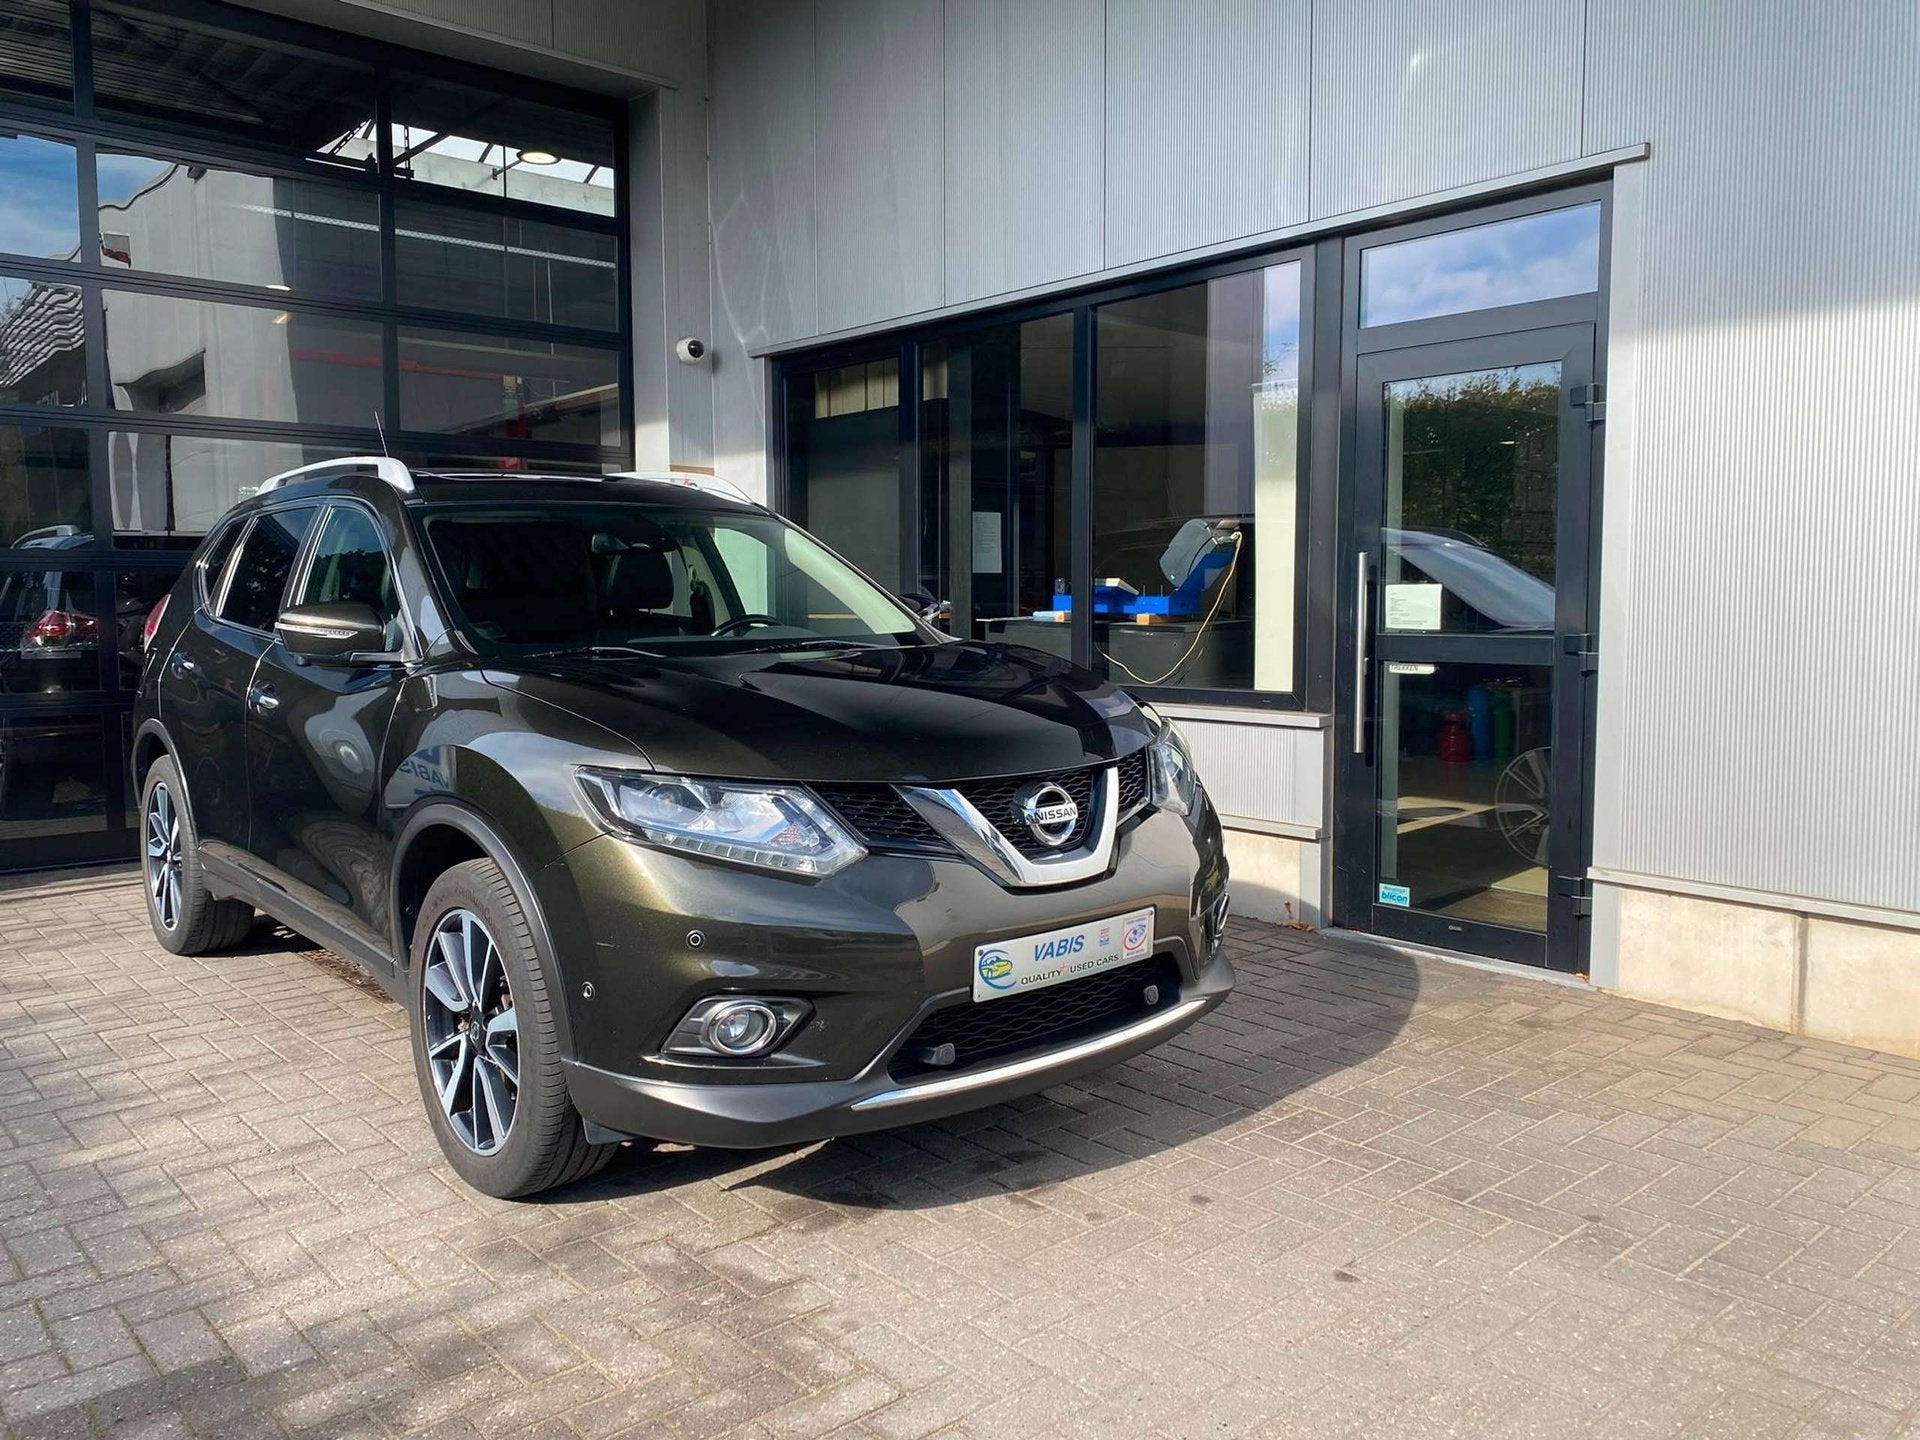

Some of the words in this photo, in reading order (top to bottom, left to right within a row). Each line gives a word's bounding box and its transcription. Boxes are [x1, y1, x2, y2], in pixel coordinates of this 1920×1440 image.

[1034, 807, 1077, 821] NISSAN
[1382, 891, 1408, 903] blicon
[1033, 935, 1085, 961] VABIS
[1021, 969, 1062, 985] QUALITY
[1069, 961, 1094, 974] USED
[1097, 954, 1119, 966] CARS
